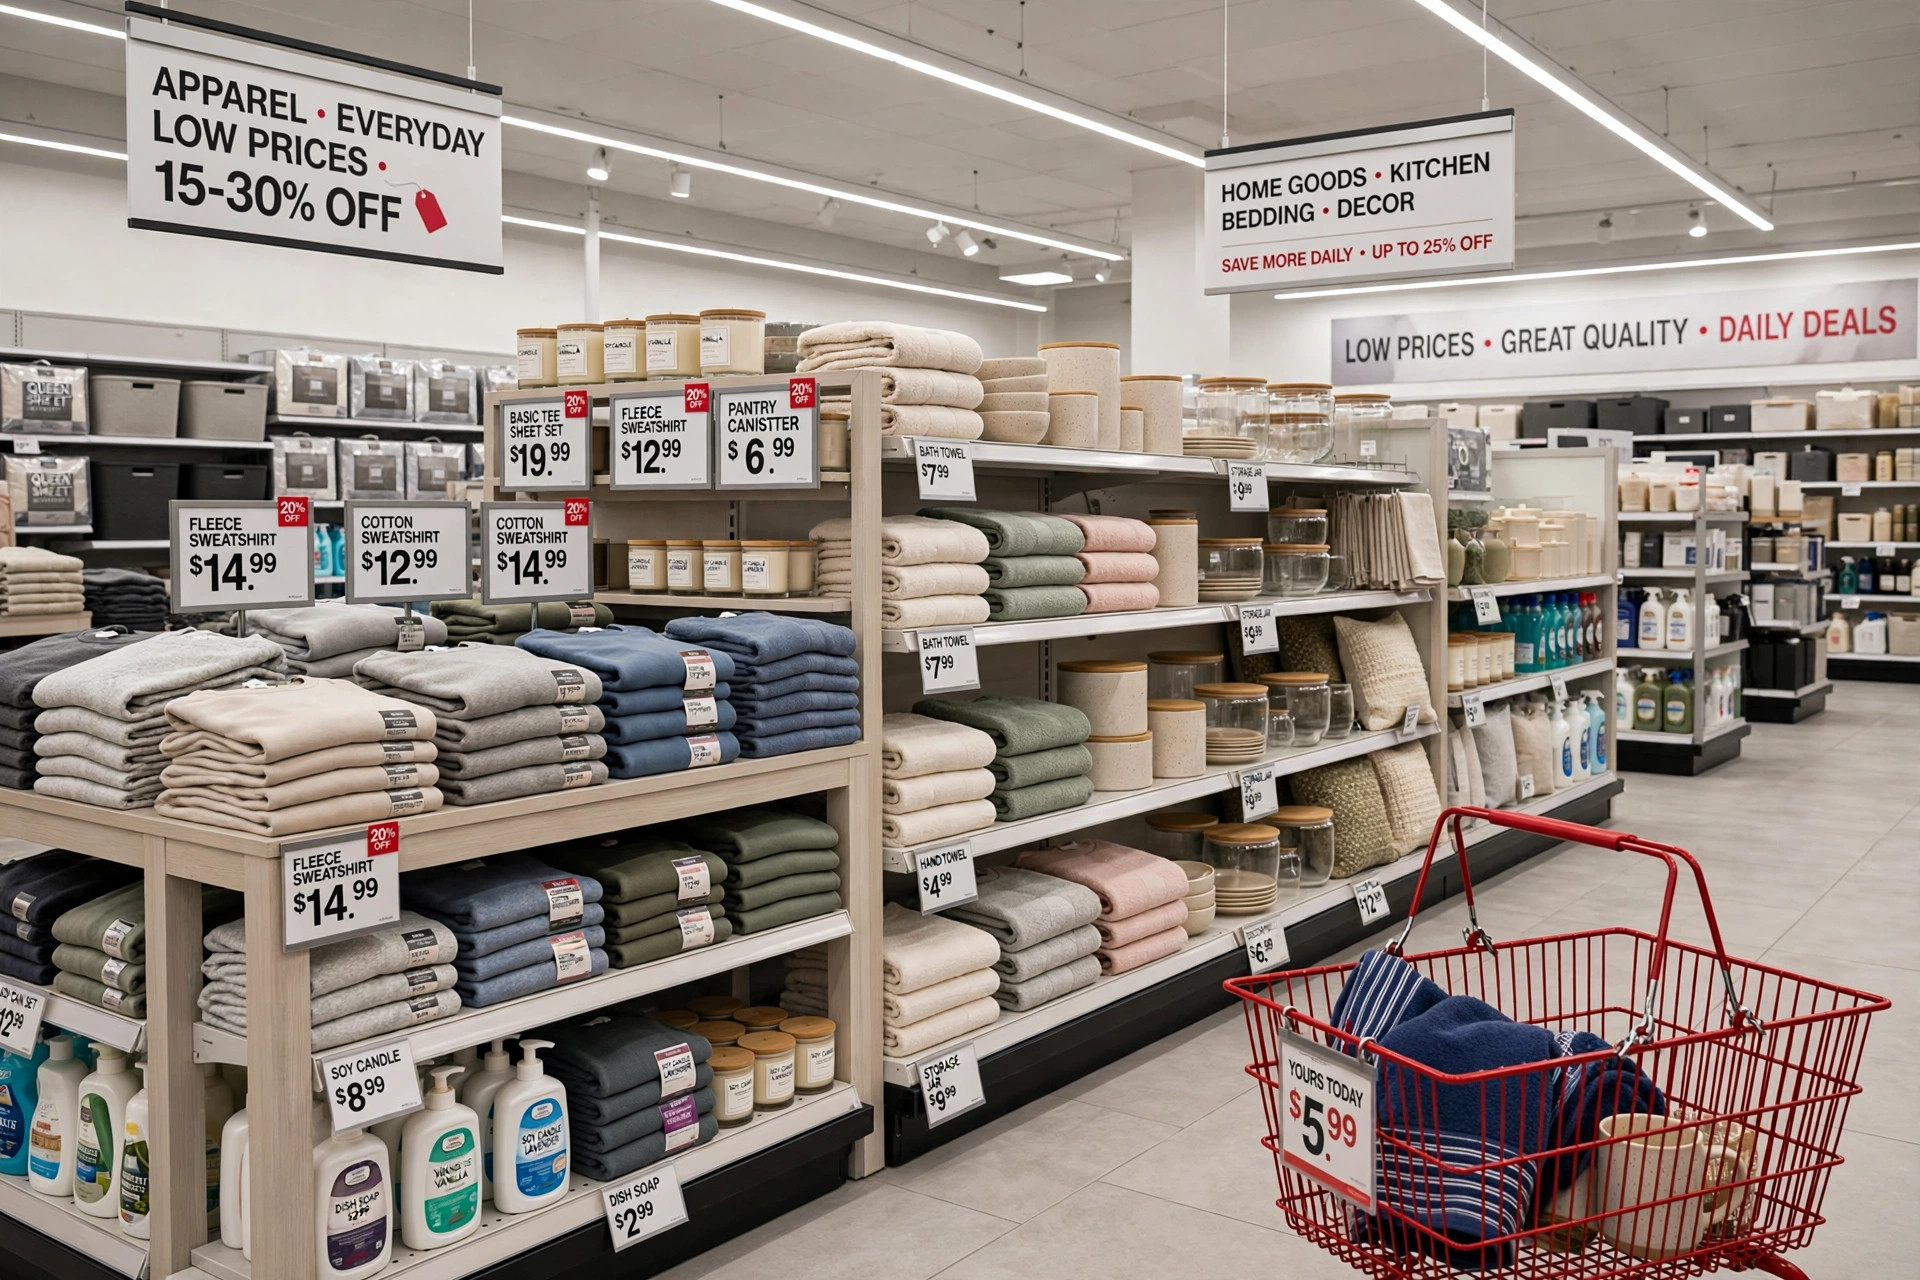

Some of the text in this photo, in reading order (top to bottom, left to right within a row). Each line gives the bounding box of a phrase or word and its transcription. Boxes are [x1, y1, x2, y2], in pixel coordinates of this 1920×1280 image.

[152, 66, 485, 158] APPAREL EVERYDAY
[153, 109, 368, 177] LOW PRICES
[1222, 152, 1490, 203] HOME GOODS KITCHEN
[155, 159, 402, 233] 15-30% OFF
[1222, 191, 1415, 231] BEDDING DECOR
[1222, 234, 1493, 273] SAVE MORE DAILY UP TO 25% OFF
[1345, 306, 1897, 364] LOW PRICES GREAT QUALITY DAILY DEALS
[686, 387, 707, 401] 20%
[792, 382, 813, 397] 20%
[566, 395, 585, 408] 20%
[689, 400, 703, 409] OFF
[795, 395, 809, 404] OFF
[570, 406, 583, 415] OFF
[622, 405, 662, 421] FLEECE
[728, 400, 777, 418] PANTRY
[510, 410, 561, 425] BASIC TEE
[727, 415, 799, 433] CANISTTER
[510, 424, 564, 439] SHEET SET
[621, 419, 687, 434] SWEATSHIRT
[919, 445, 966, 460] BATH TOWEL
[280, 501, 306, 515] 20%
[566, 502, 587, 515] 20%
[189, 517, 242, 532] FLEECE
[284, 513, 300, 523] OFF
[361, 516, 413, 530] COTTON
[496, 516, 544, 530] COTTON
[570, 513, 584, 523] OFF
[189, 533, 277, 548] SWEATSHIRT
[361, 530, 440, 545] SWEATSHIRT
[496, 531, 568, 545] SWEATSHIRT
[922, 635, 970, 650] BATH TOWEL
[370, 827, 396, 844] 20%
[374, 840, 392, 851] OFF
[293, 850, 341, 871] FLEECE
[920, 849, 967, 870] HAND TOWEL
[293, 859, 374, 886] SWEATSHIRT
[331, 1049, 401, 1080] SOY CANDLE
[1288, 1059, 1363, 1108] YOURS TODAY
[609, 1176, 660, 1207] DISH SOAP
[335, 1191, 380, 1214] DISH SOAP
